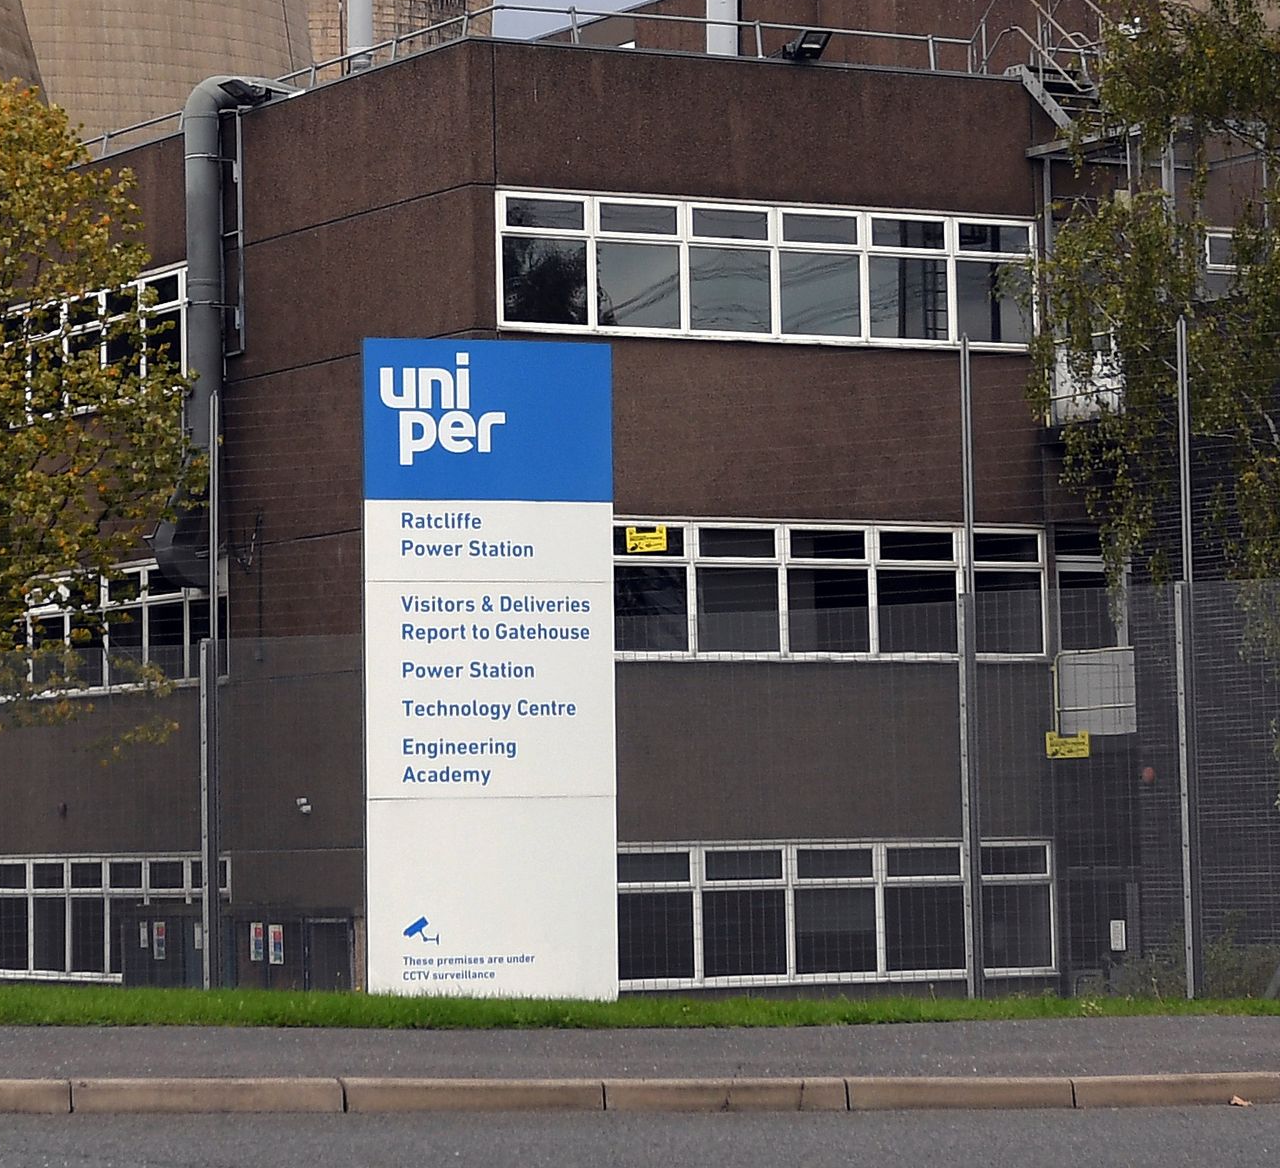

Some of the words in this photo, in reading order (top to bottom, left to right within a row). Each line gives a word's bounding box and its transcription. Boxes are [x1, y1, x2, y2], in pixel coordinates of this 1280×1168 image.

[380, 353, 469, 409] uni
[399, 411, 505, 465] per
[402, 513, 481, 529] Ratcliffe
[402, 540, 463, 556] Power
[469, 540, 533, 557] Station
[401, 596, 475, 612] Visitors
[482, 596, 493, 612] &
[501, 596, 590, 612] Deliveries
[402, 624, 465, 643] Report
[472, 624, 489, 639] to
[496, 623, 589, 639] Gatehouse
[403, 662, 463, 678] Power
[470, 662, 534, 678] Station
[402, 700, 511, 720] Technology
[518, 700, 576, 716] Centre
[403, 738, 516, 759] Engineering
[403, 766, 490, 785] Academy
[403, 956, 433, 965] These
[437, 956, 484, 966] premises
[507, 954, 534, 963] under
[403, 971, 429, 980] CCTV
[433, 970, 495, 979] surveillance
